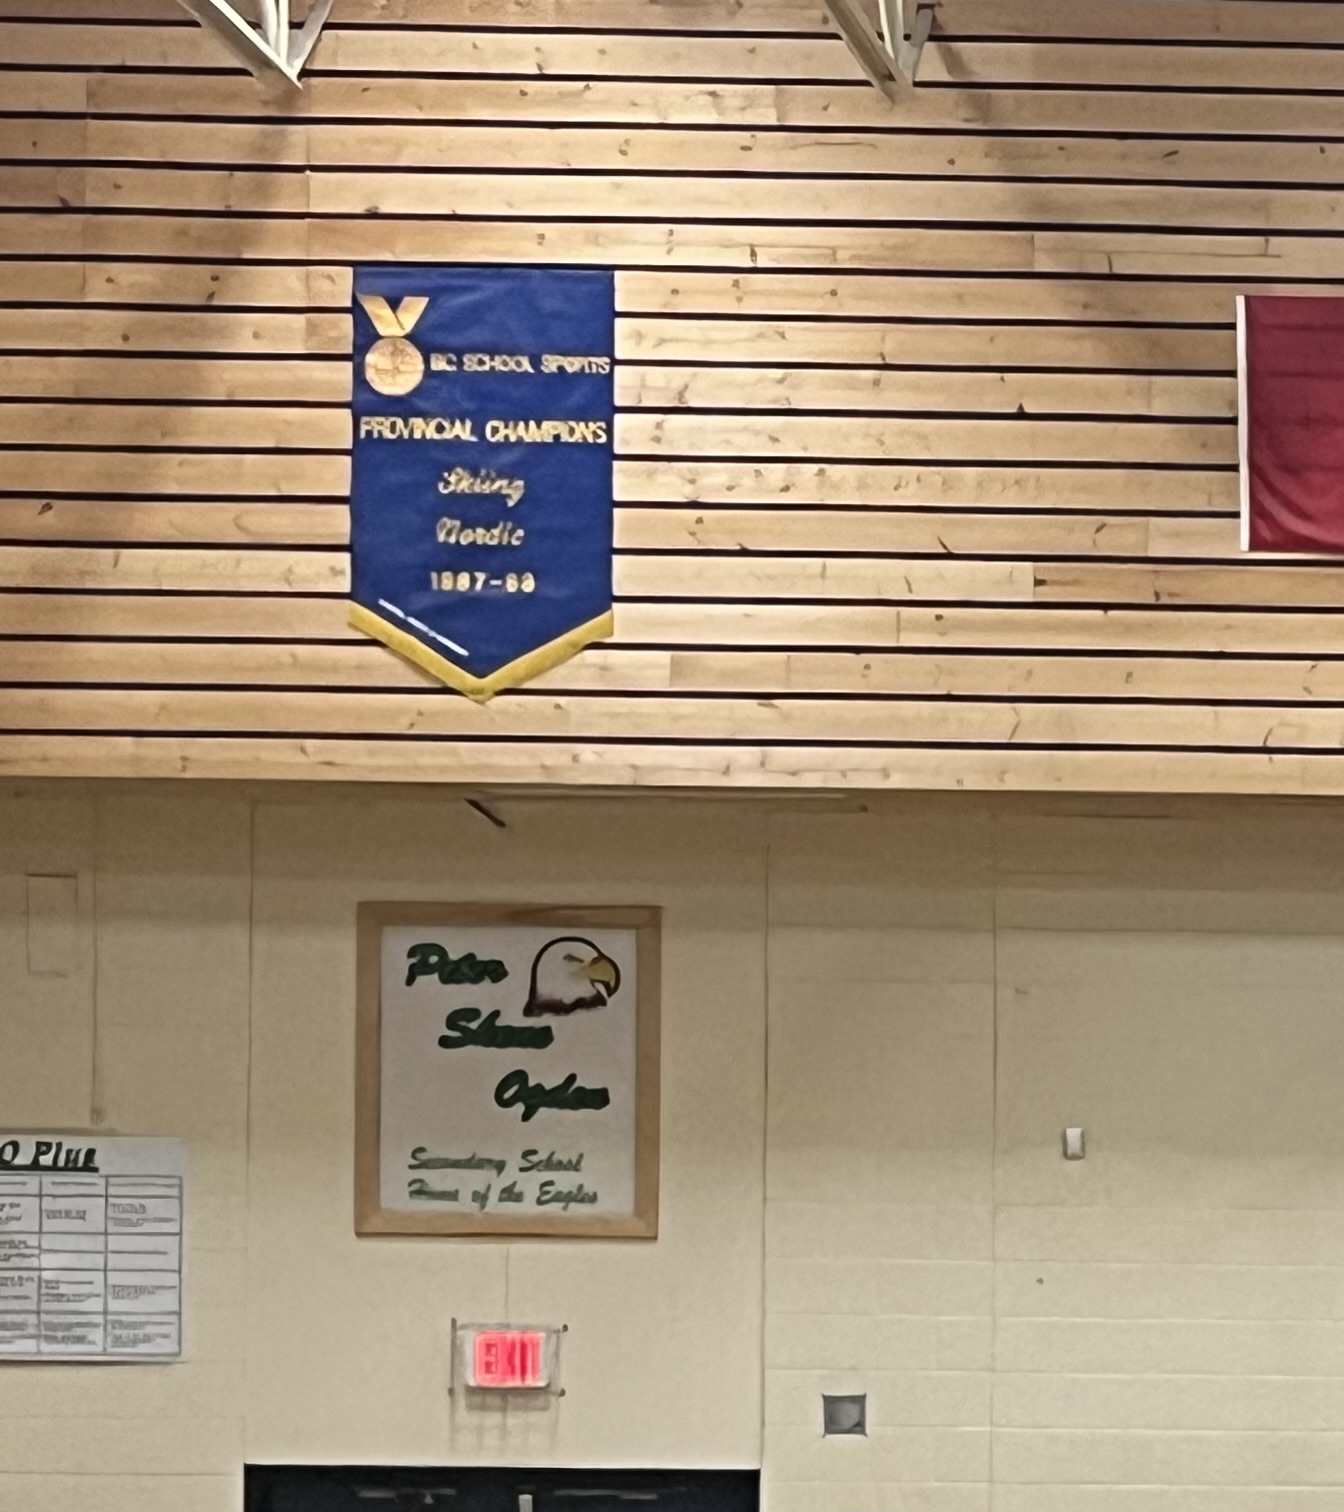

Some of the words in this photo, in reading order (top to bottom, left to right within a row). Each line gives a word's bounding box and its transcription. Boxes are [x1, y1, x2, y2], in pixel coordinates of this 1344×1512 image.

[463, 353, 535, 373] SCHOOL
[540, 354, 611, 374] SPORTS
[360, 416, 478, 441] PROVINCIAL
[485, 420, 607, 443] CHAMPIONS
